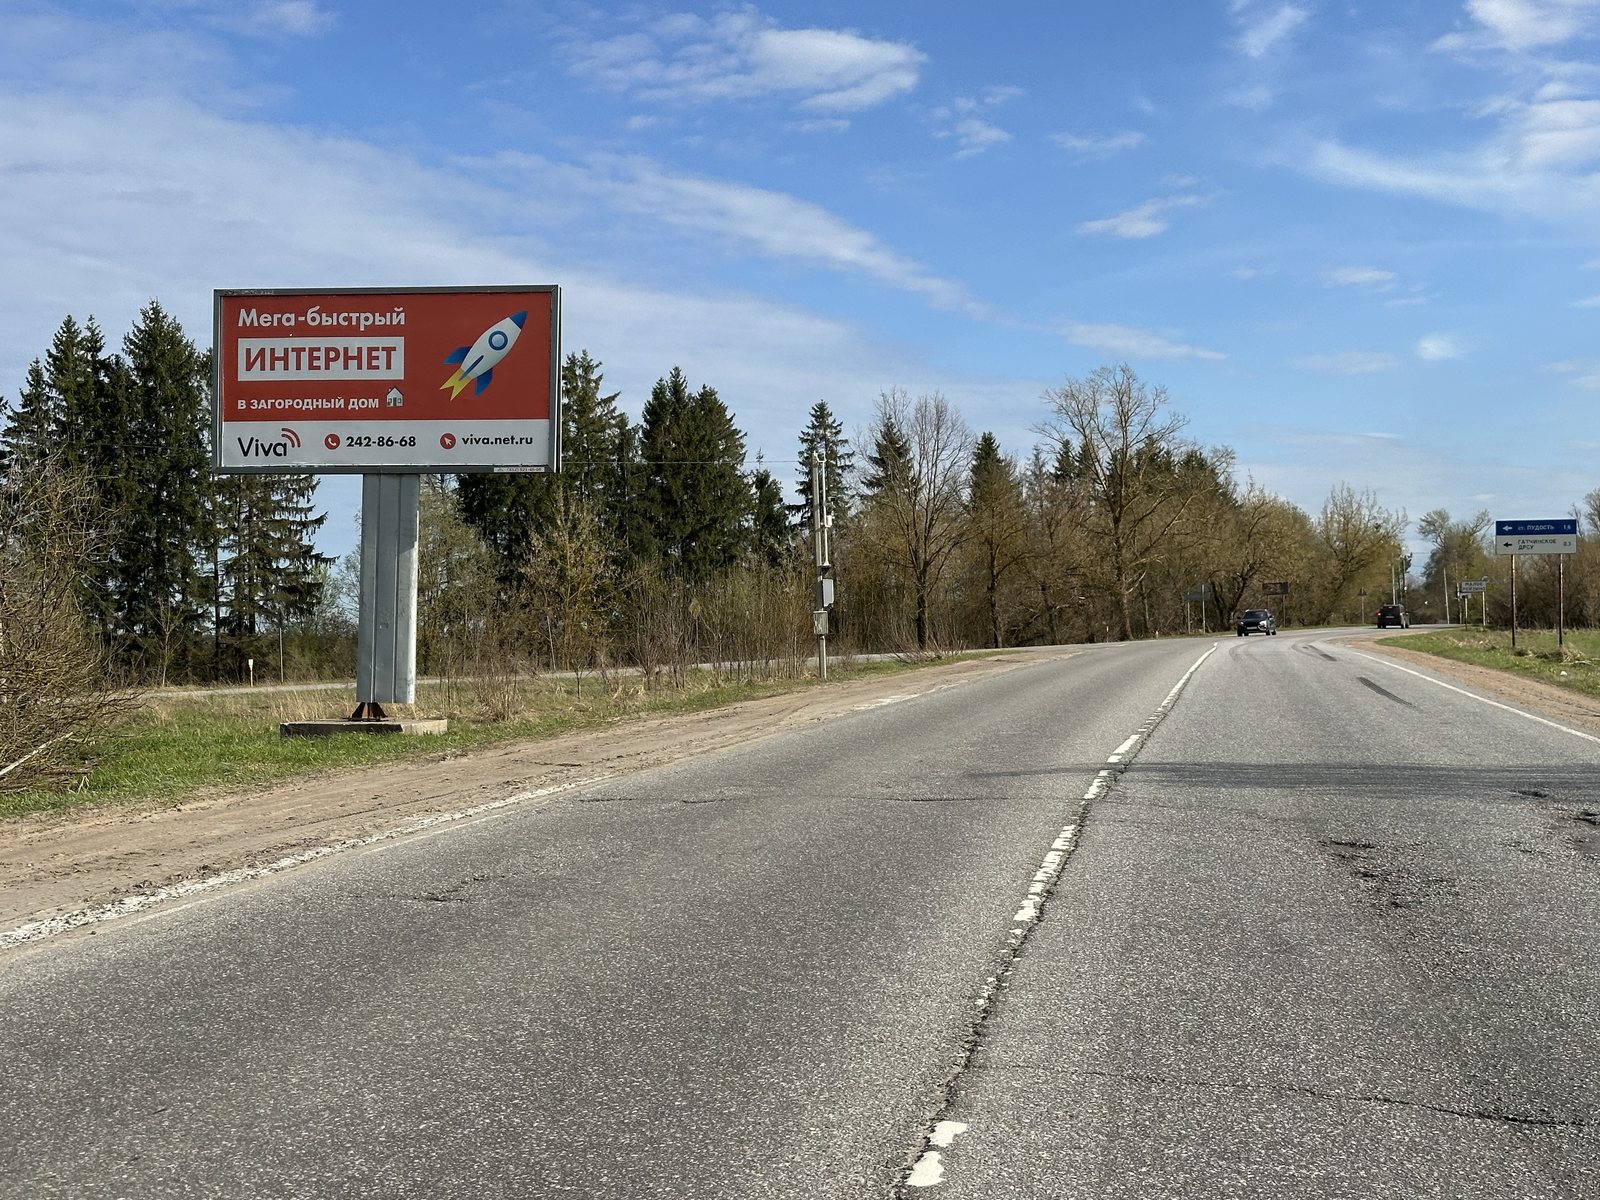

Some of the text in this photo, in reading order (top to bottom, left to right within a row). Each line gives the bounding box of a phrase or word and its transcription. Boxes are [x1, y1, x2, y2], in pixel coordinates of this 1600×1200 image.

[238, 306, 405, 331] Мега-быстрый
[245, 346, 397, 372] ИНТЕРНЕТ
[238, 397, 379, 411] В ЗАГОРОДНЫЙ ДОМ
[237, 436, 288, 457] Viva
[346, 436, 417, 448] 242-86-68
[461, 433, 533, 445] viva.net.ru
